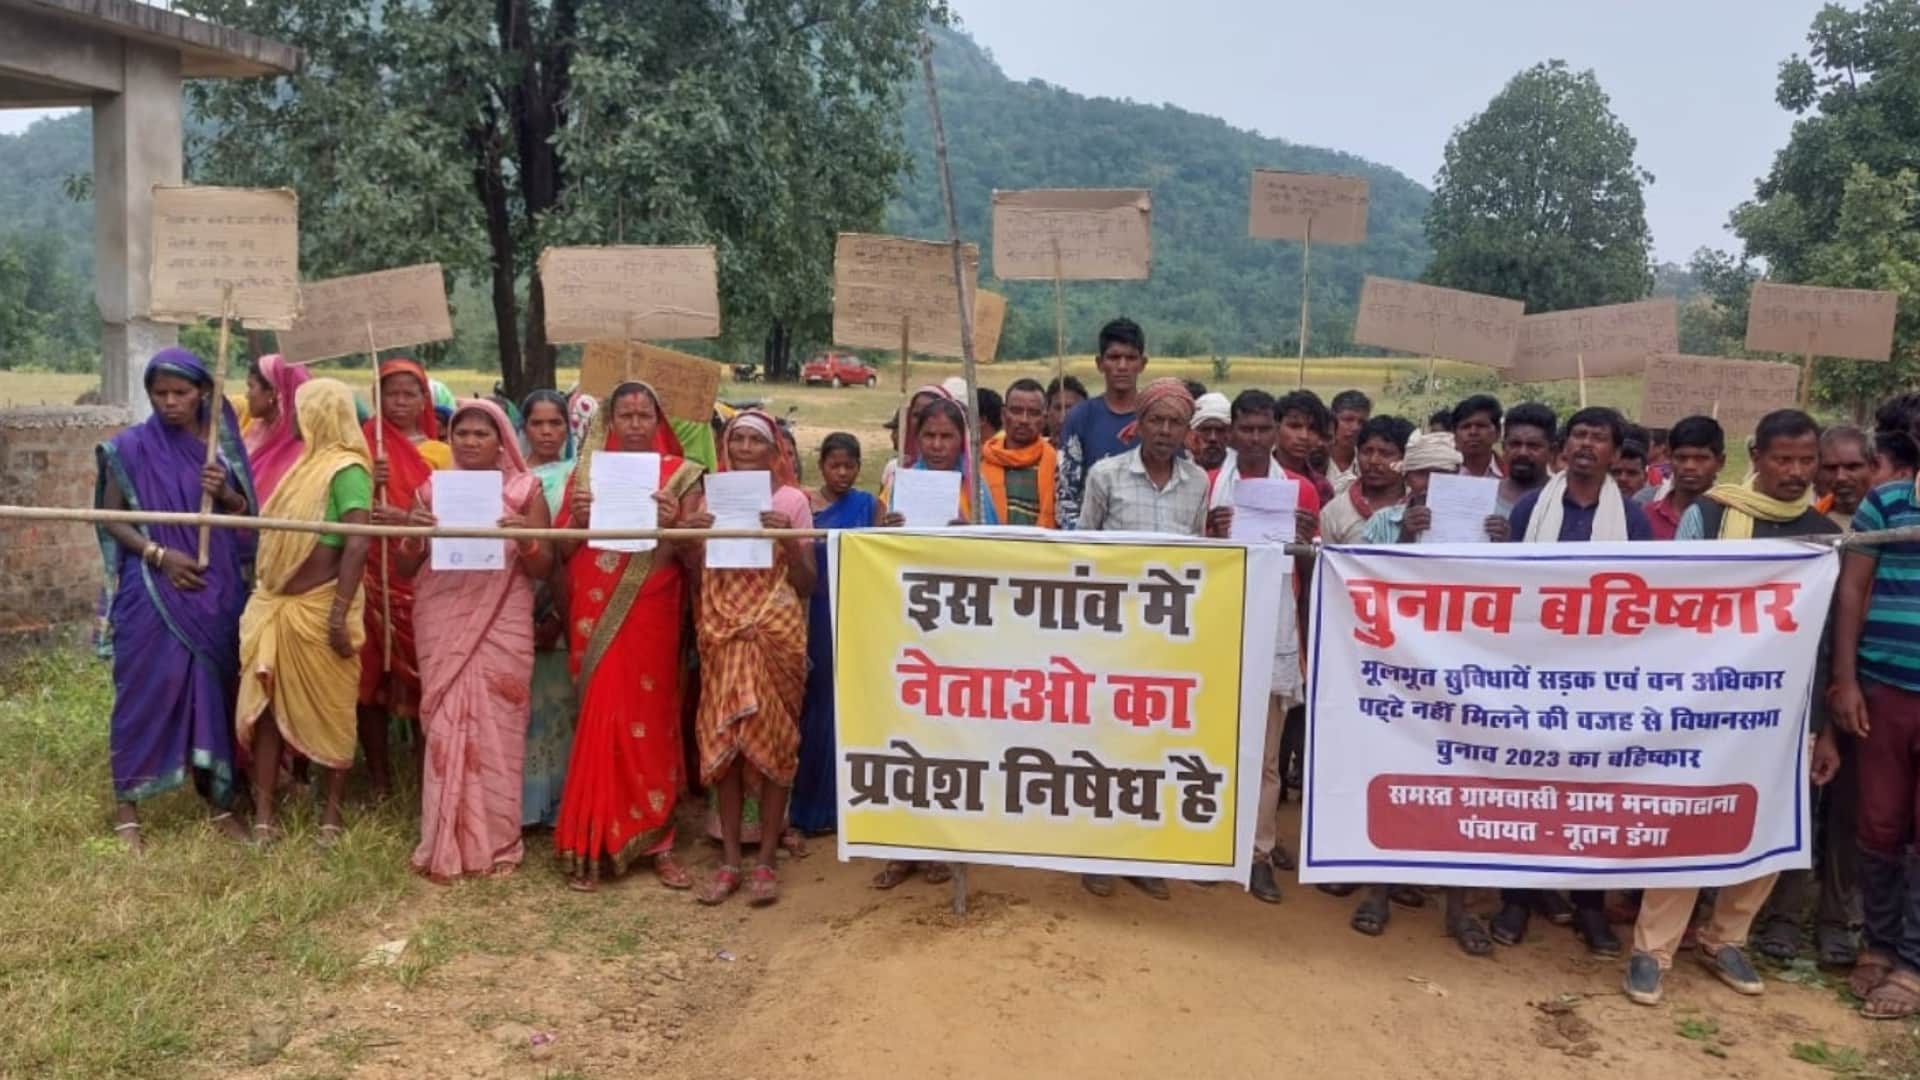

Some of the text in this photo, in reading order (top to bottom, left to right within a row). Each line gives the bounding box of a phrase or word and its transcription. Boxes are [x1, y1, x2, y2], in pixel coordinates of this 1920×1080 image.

[902, 565, 1201, 636] इस गांव में
[1347, 571, 1800, 649] चुनाव बहिष्कार
[896, 648, 1197, 730] नेताओ का
[1360, 659, 1787, 697] मूलभूत सुविधायें सड़क एवं वन अधिकार
[1411, 700, 1457, 722] नहीं
[1460, 703, 1531, 730] मिलने
[1536, 704, 1570, 731] की
[1575, 711, 1635, 732] वजह
[1640, 706, 1664, 733] से
[1669, 706, 1782, 731] विधानसभा
[1436, 739, 1703, 769] चुनाव 2023 का बहिष्कार
[845, 740, 1223, 824] प्रवेश निषेध है
[1388, 785, 1454, 806] समस्त
[1459, 785, 1558, 810] ग्रामवासी
[1566, 791, 1615, 813] ग्राम
[1458, 816, 1538, 842] पंचायत
[1562, 823, 1620, 851] नूतन
[1625, 821, 1669, 846] डंगा
